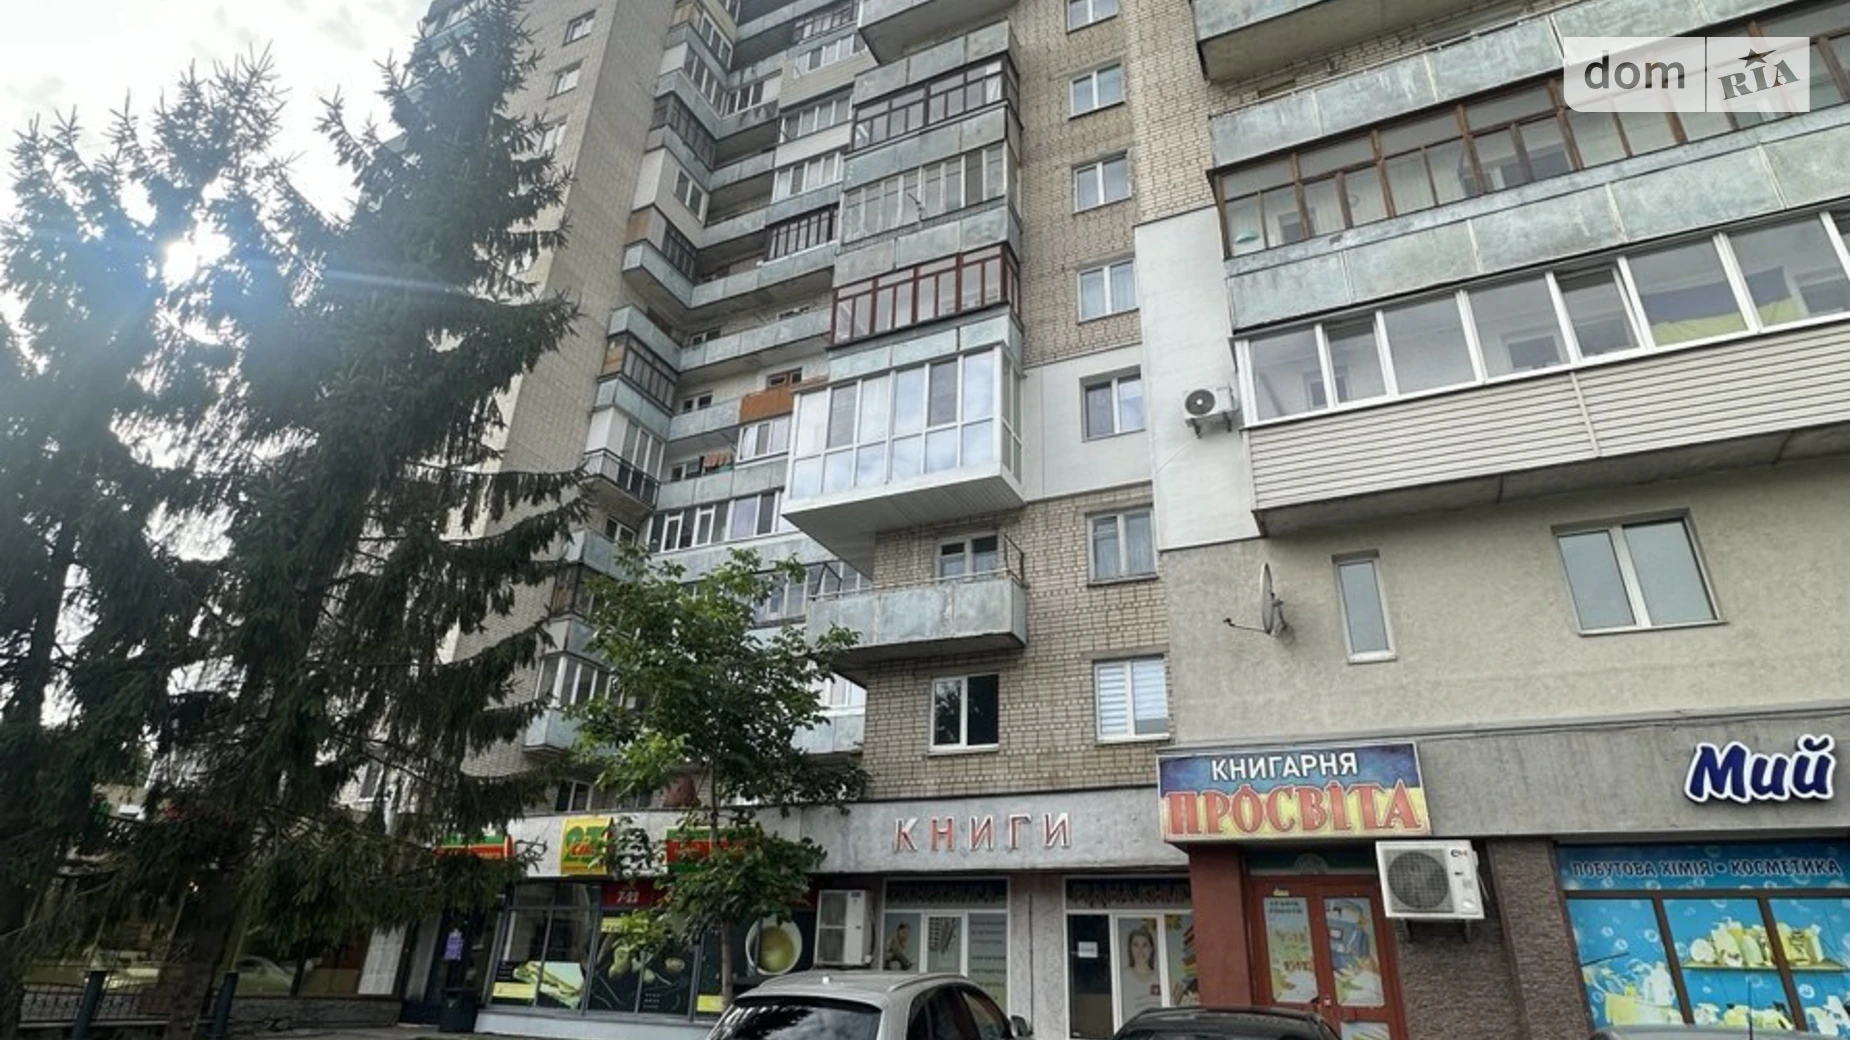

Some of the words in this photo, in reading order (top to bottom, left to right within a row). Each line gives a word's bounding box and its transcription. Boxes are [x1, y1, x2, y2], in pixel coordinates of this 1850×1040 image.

[1211, 751, 1358, 782] КНИГАРНЯ
[1684, 733, 1836, 804] Мий
[1166, 779, 1421, 835] ПРОСВІТА
[893, 811, 1072, 852] КНИГИ
[1571, 860, 1657, 878] ПОБУТОВА
[1660, 859, 1713, 877] ХІМІЯ
[1730, 858, 1842, 876] КОСМЕТИКА
